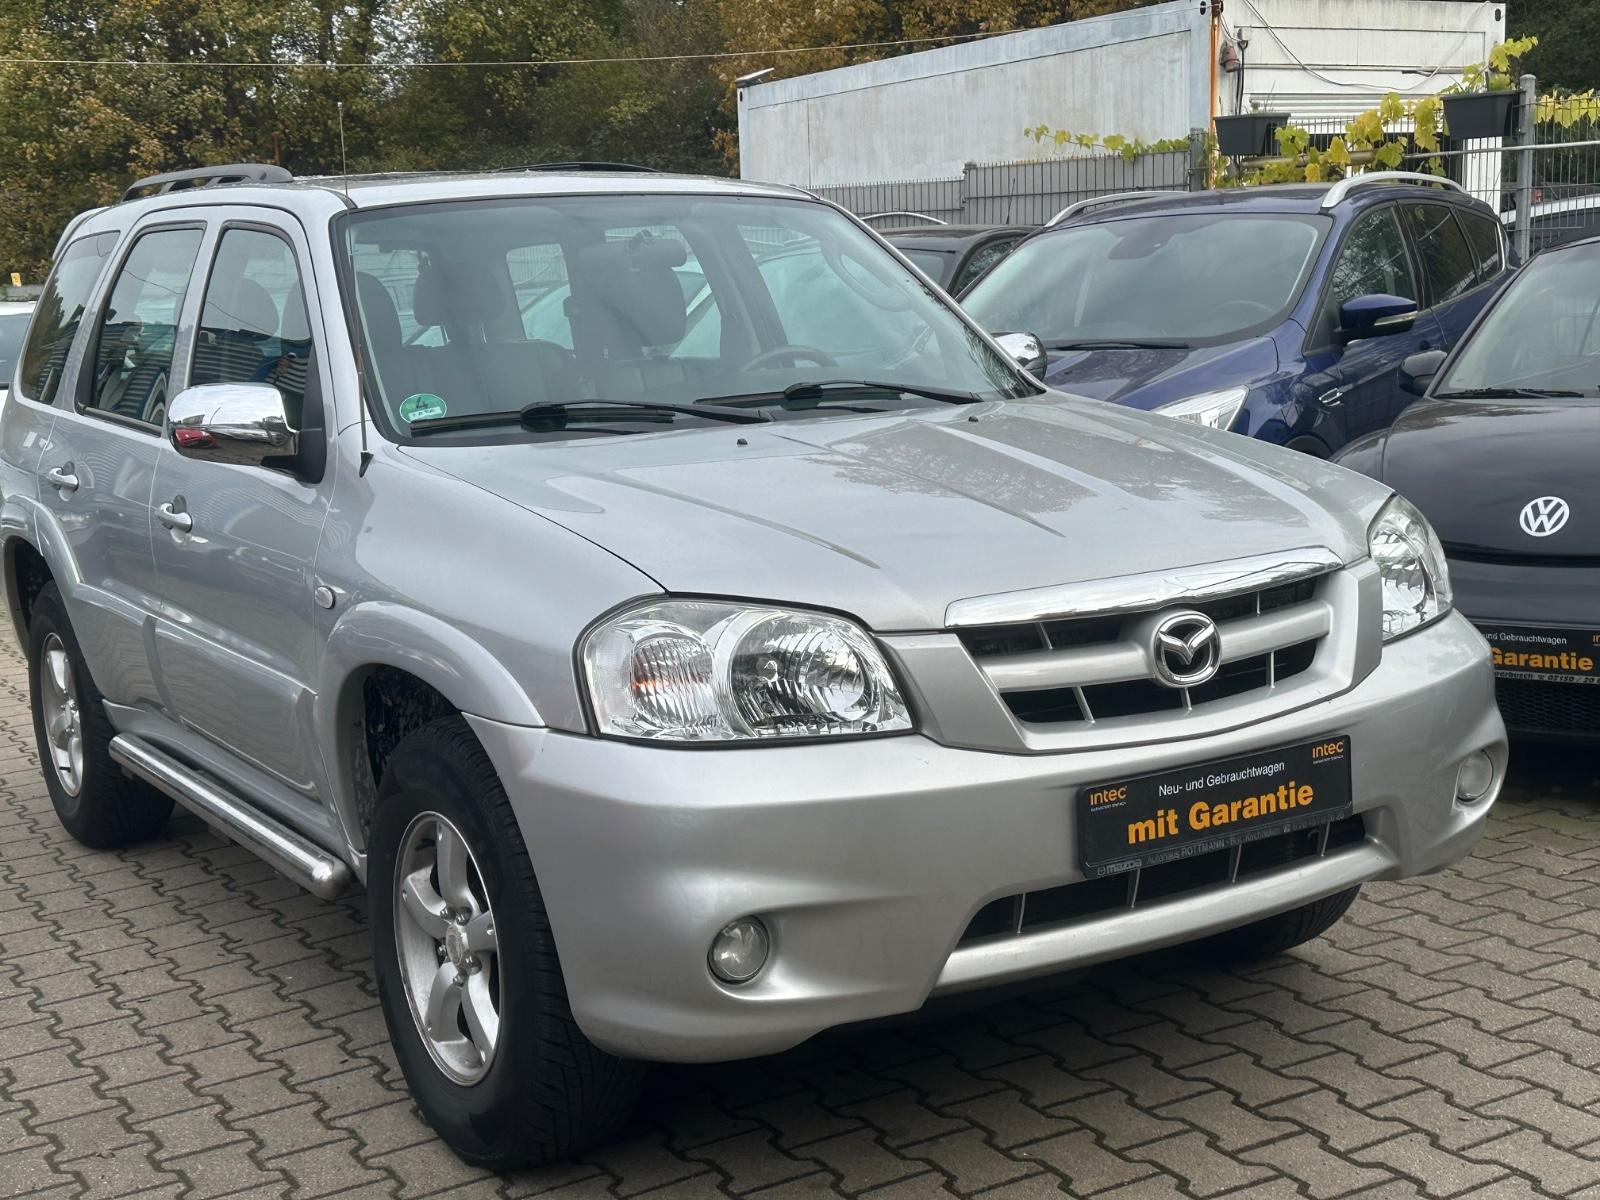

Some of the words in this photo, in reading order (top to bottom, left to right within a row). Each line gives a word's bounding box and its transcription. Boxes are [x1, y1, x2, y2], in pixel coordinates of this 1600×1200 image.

[1499, 632, 1567, 646] Gebrauchtwagen
[1158, 783, 1183, 797] Neu-
[1185, 776, 1204, 791] und
[1206, 761, 1285, 788] Gebrauchtwagen
[1128, 809, 1178, 844] mit
[1188, 780, 1314, 832] Garantie
